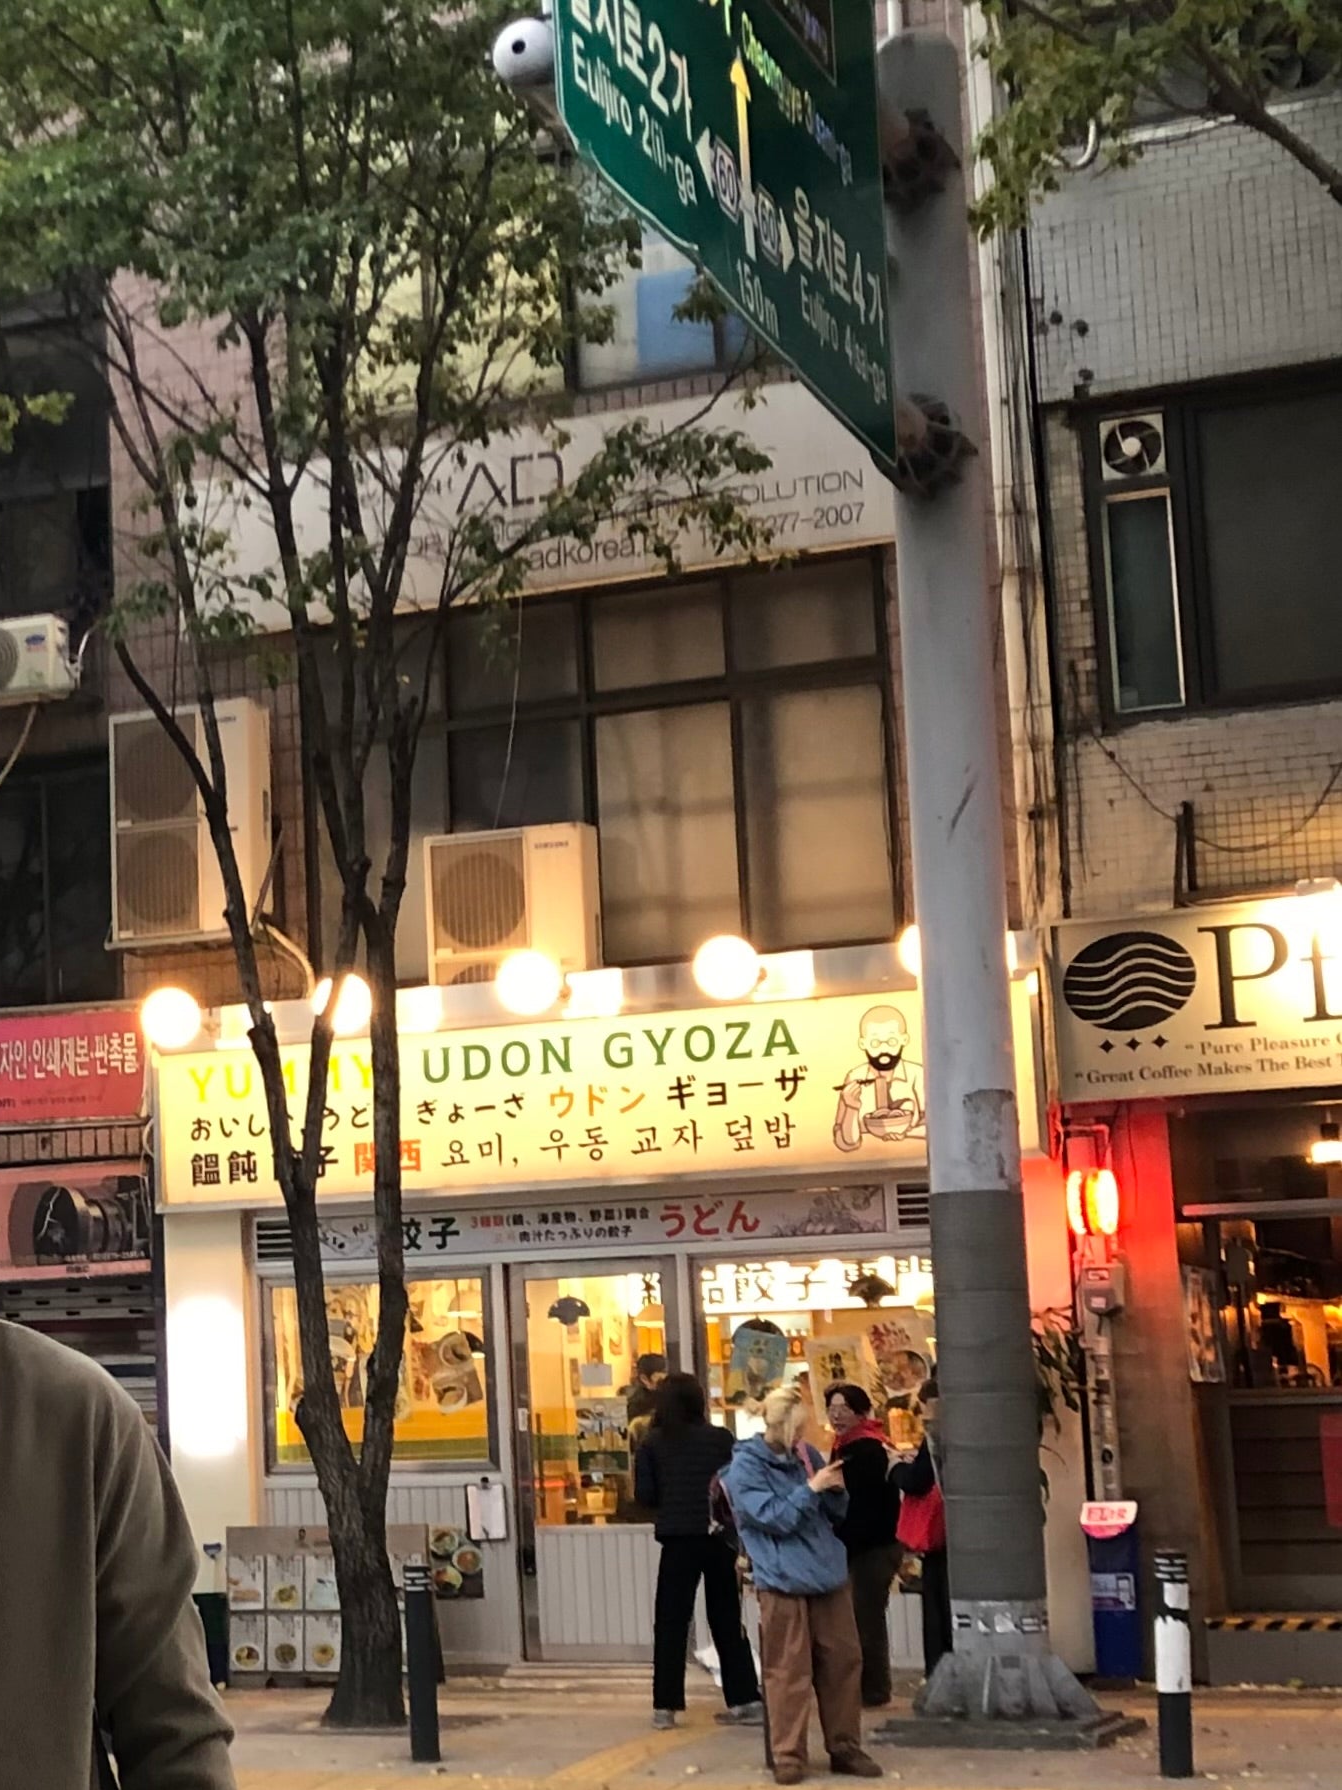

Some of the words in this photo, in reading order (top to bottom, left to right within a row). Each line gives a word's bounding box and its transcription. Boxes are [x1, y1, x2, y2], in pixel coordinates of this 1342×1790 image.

[793, 186, 885, 347] 을지로4가
[422, 1035, 574, 1084] UDON
[603, 1018, 800, 1070] GYOZA
[1139, 1062, 1193, 1081] Coffee
[1197, 1059, 1253, 1077] Makes
[1256, 1056, 1291, 1073] The
[1295, 1053, 1332, 1071] Best
[415, 1091, 526, 1126] ぎょーざ
[548, 1082, 646, 1119] ウドン
[666, 1064, 809, 1111] ギョーザ
[539, 1124, 610, 1162] 우동
[630, 1118, 704, 1155] 교자
[724, 1110, 797, 1152] 덮밥
[659, 1200, 762, 1238] うどん
